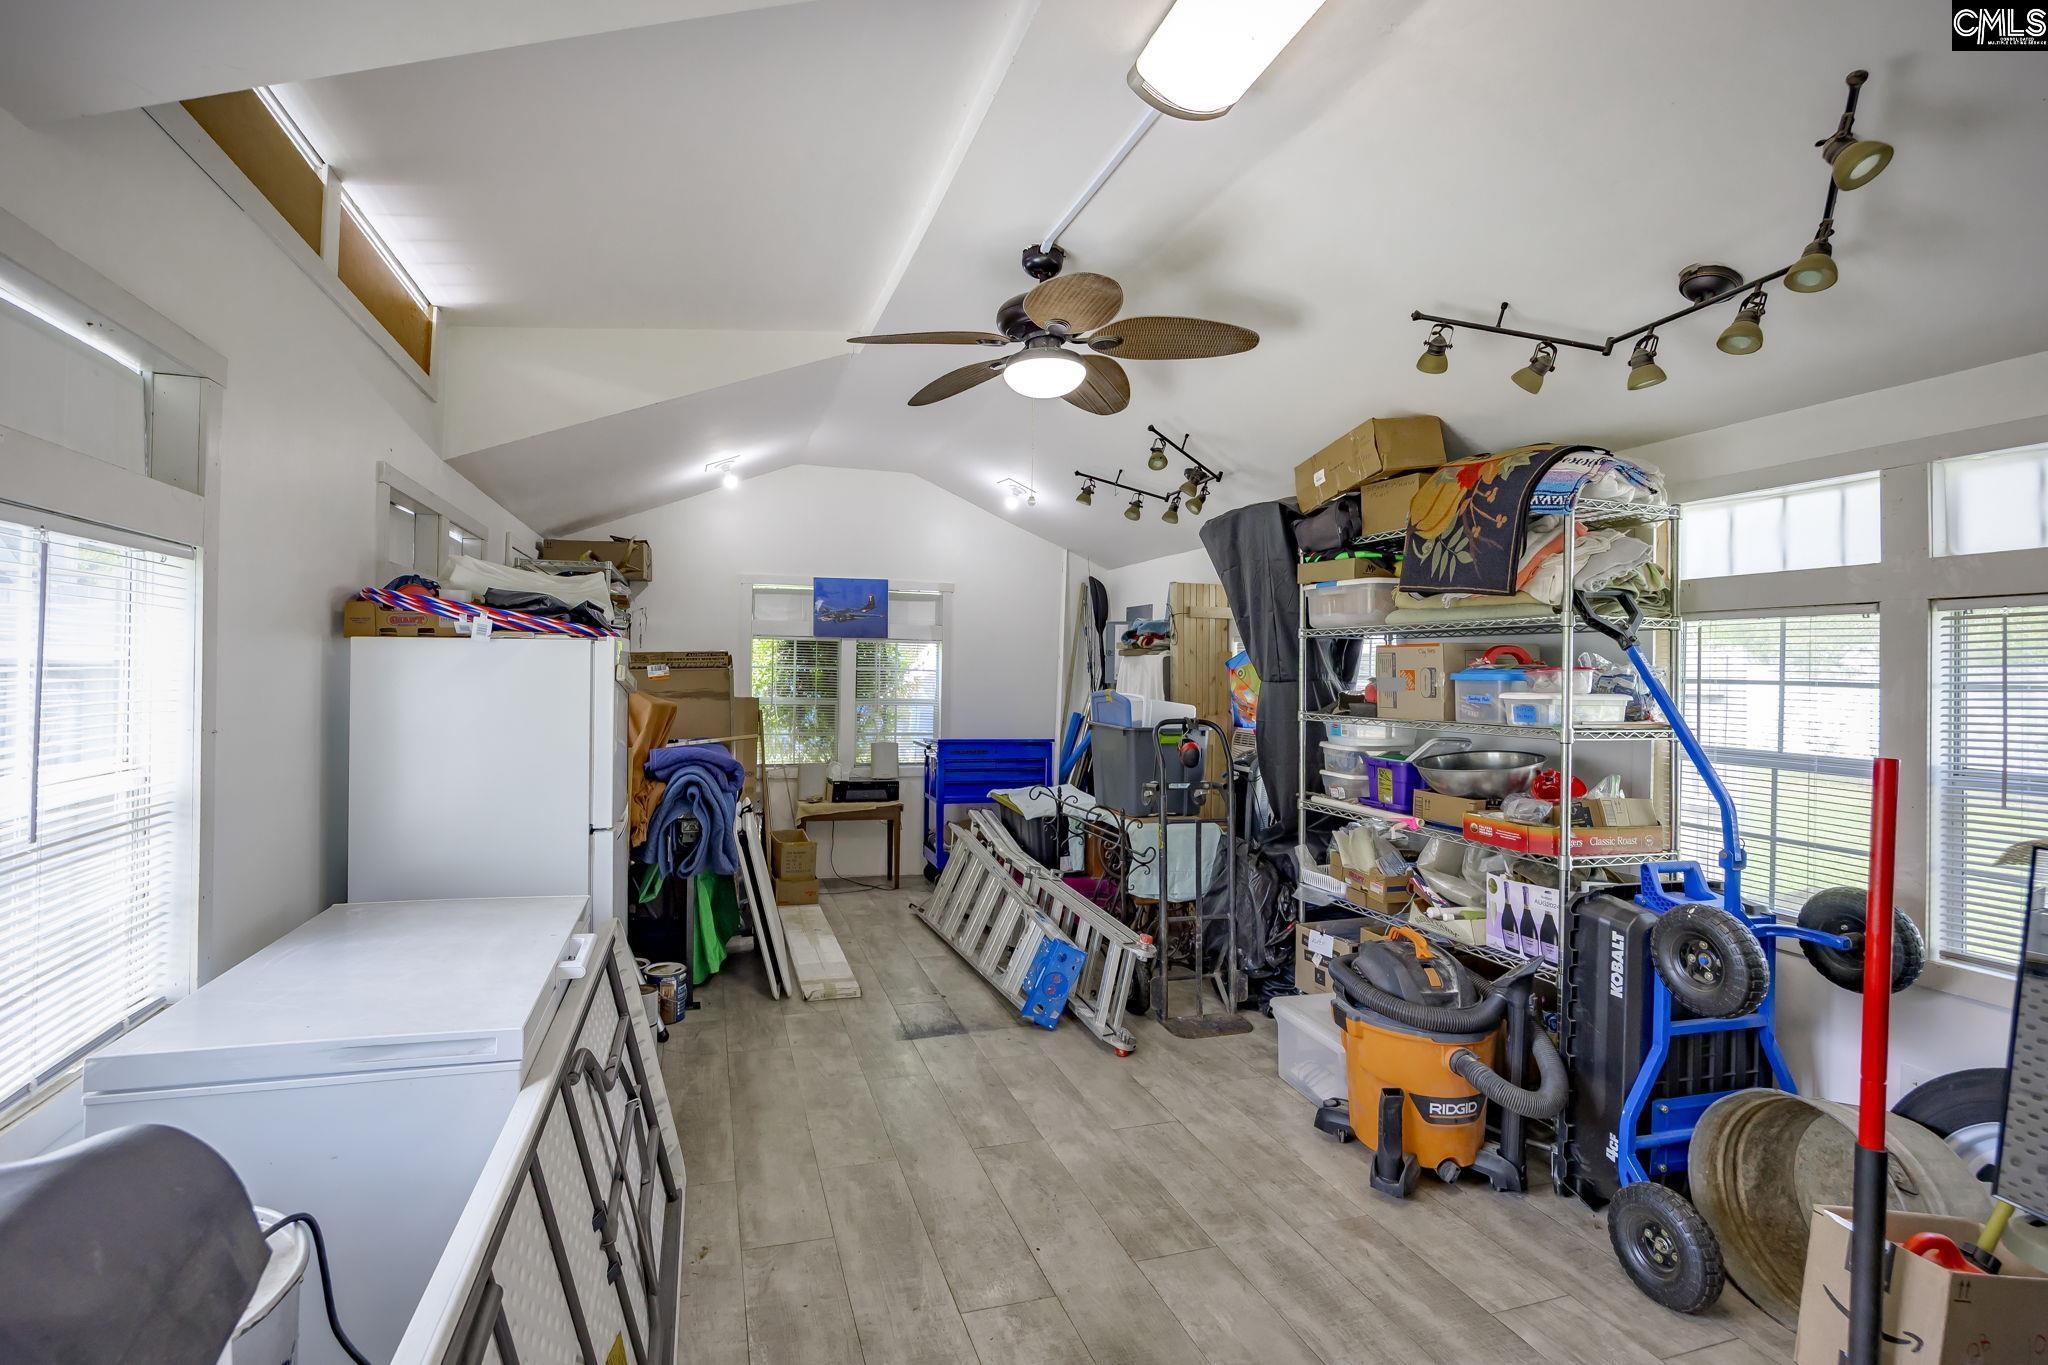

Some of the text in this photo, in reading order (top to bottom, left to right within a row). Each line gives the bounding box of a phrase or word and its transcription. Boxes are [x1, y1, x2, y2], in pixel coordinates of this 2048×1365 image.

[1590, 836, 1616, 846] Classic
[1617, 836, 1638, 845] Roast
[1610, 930, 1625, 999] KOBALT
[1429, 1102, 1478, 1115] RIDGID
